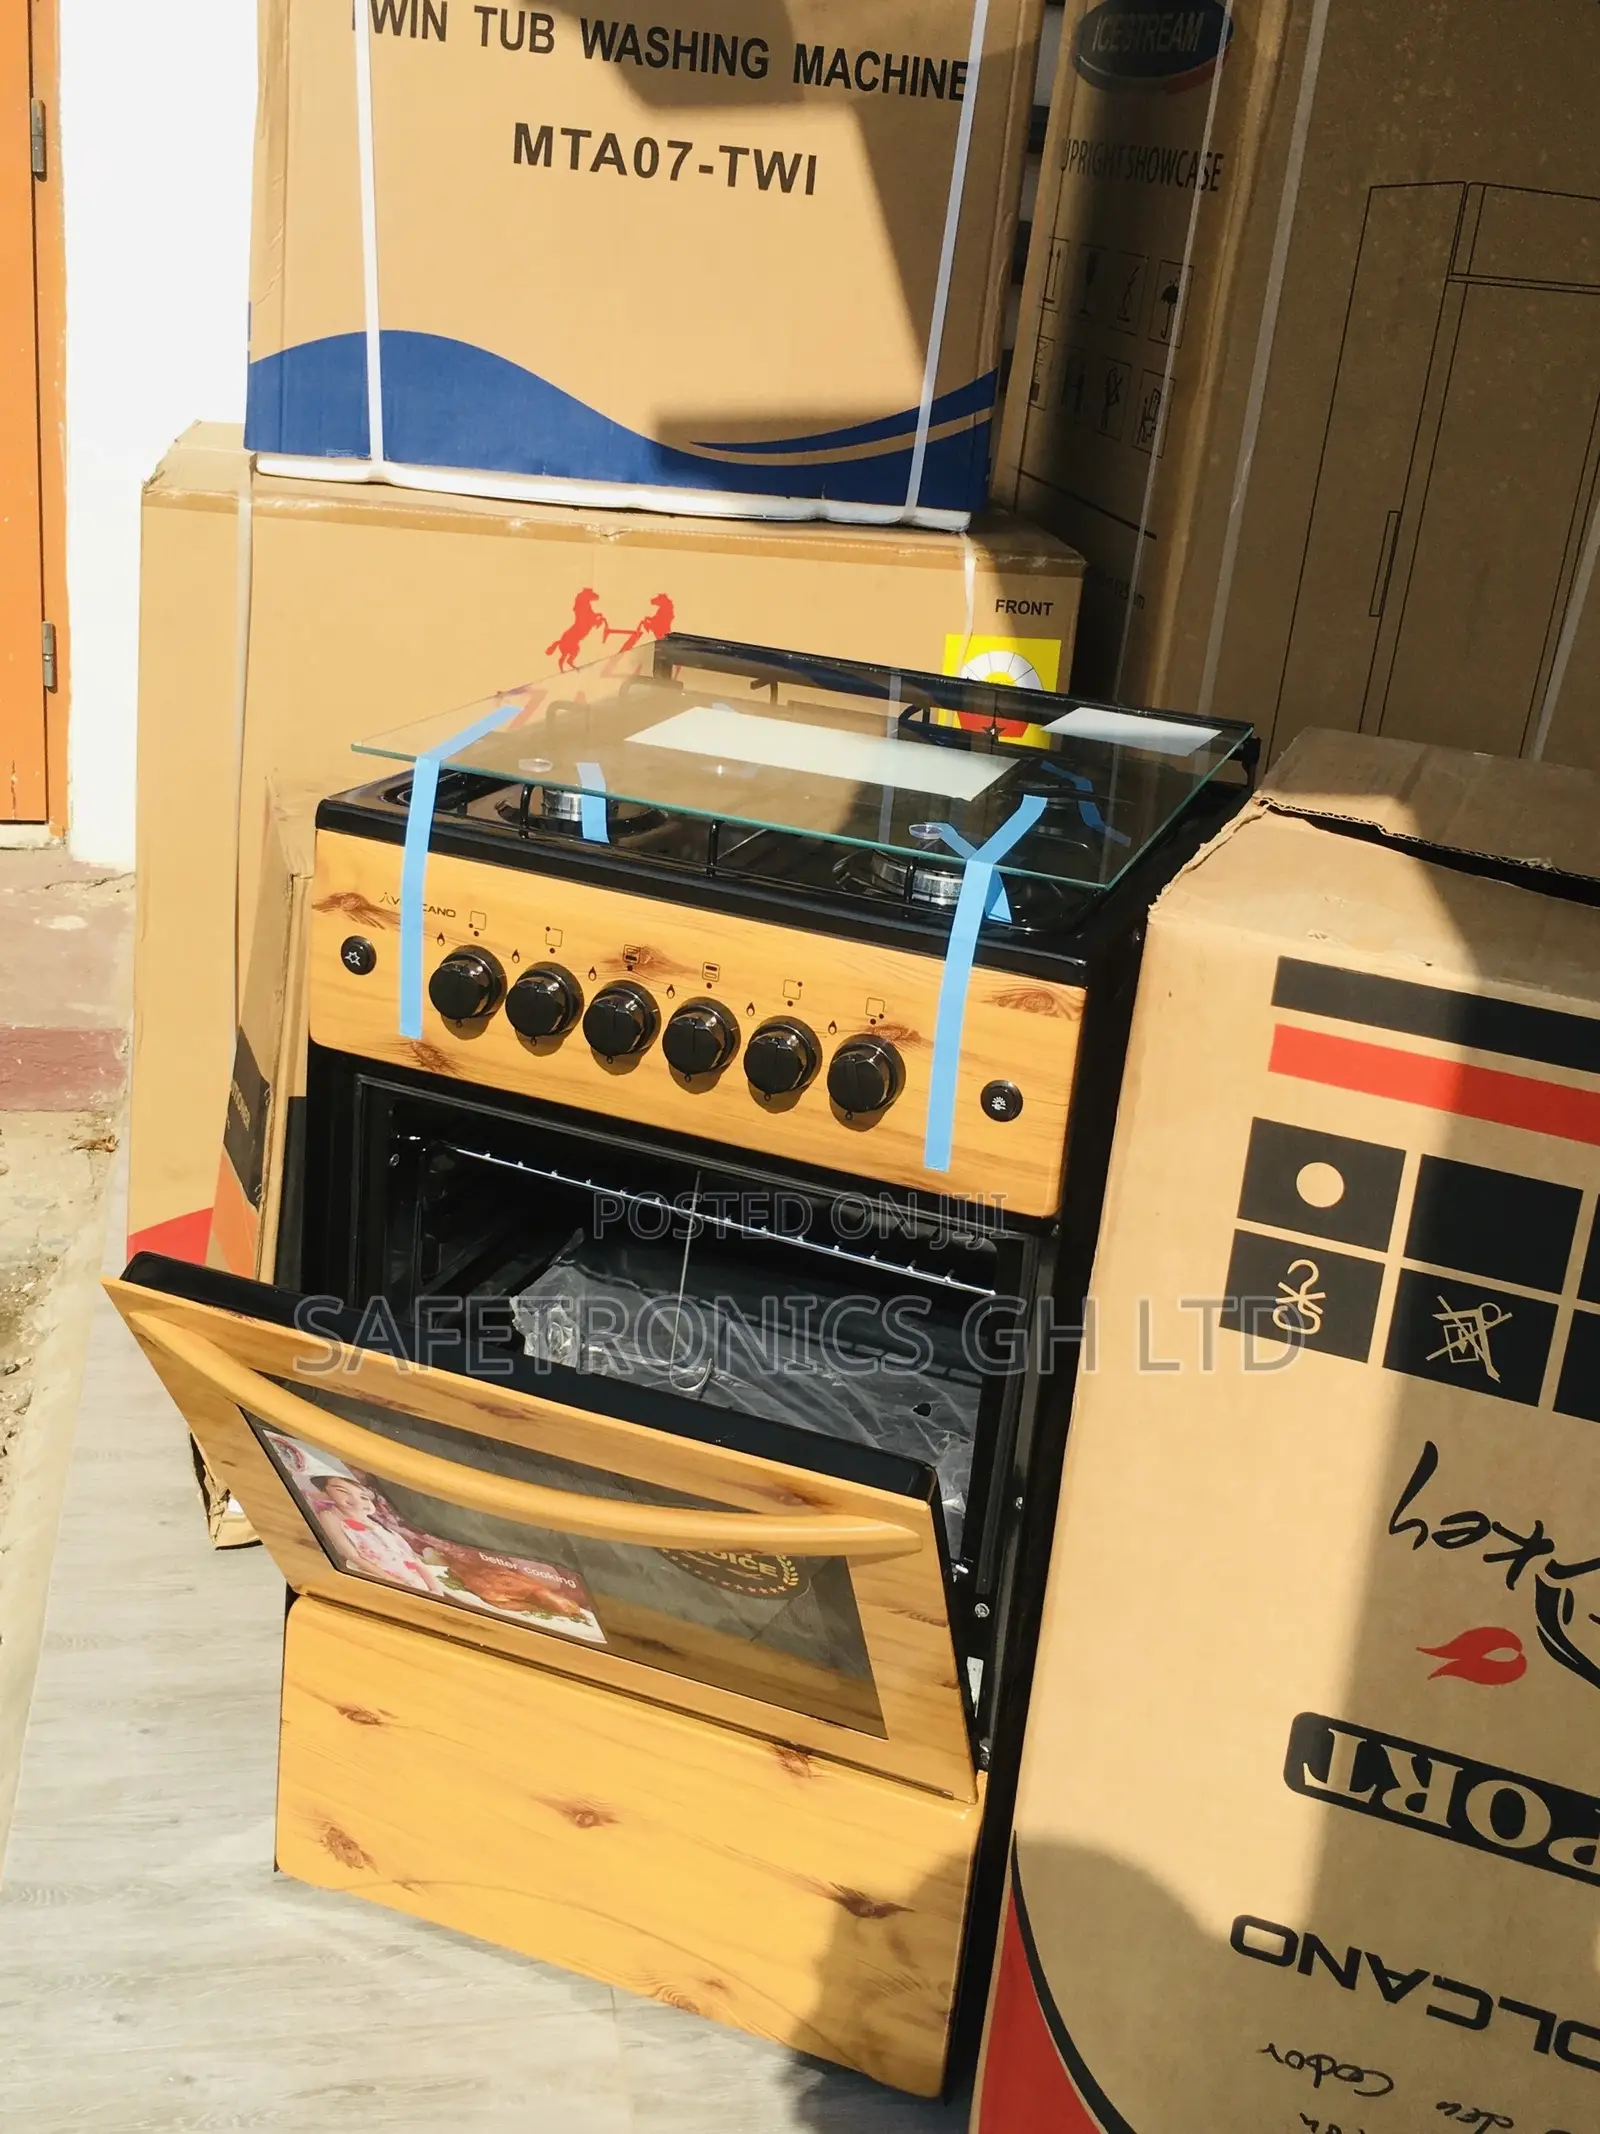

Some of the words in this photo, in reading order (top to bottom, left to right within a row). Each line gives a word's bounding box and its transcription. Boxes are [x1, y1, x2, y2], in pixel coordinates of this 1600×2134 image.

[352, 0, 447, 42] WIN
[474, 5, 555, 54] TUB
[580, 17, 770, 79] WASHING
[793, 43, 968, 102] MACHINE
[1091, 11, 1206, 52] ICESTREAM
[512, 122, 818, 196] MTA07-TWI
[1061, 137, 1126, 178] UPRIGHT
[1124, 143, 1224, 192] SHOWCASE
[995, 599, 1054, 616] FRONT
[478, 1551, 518, 1570] better
[523, 1566, 577, 1589] cooking
